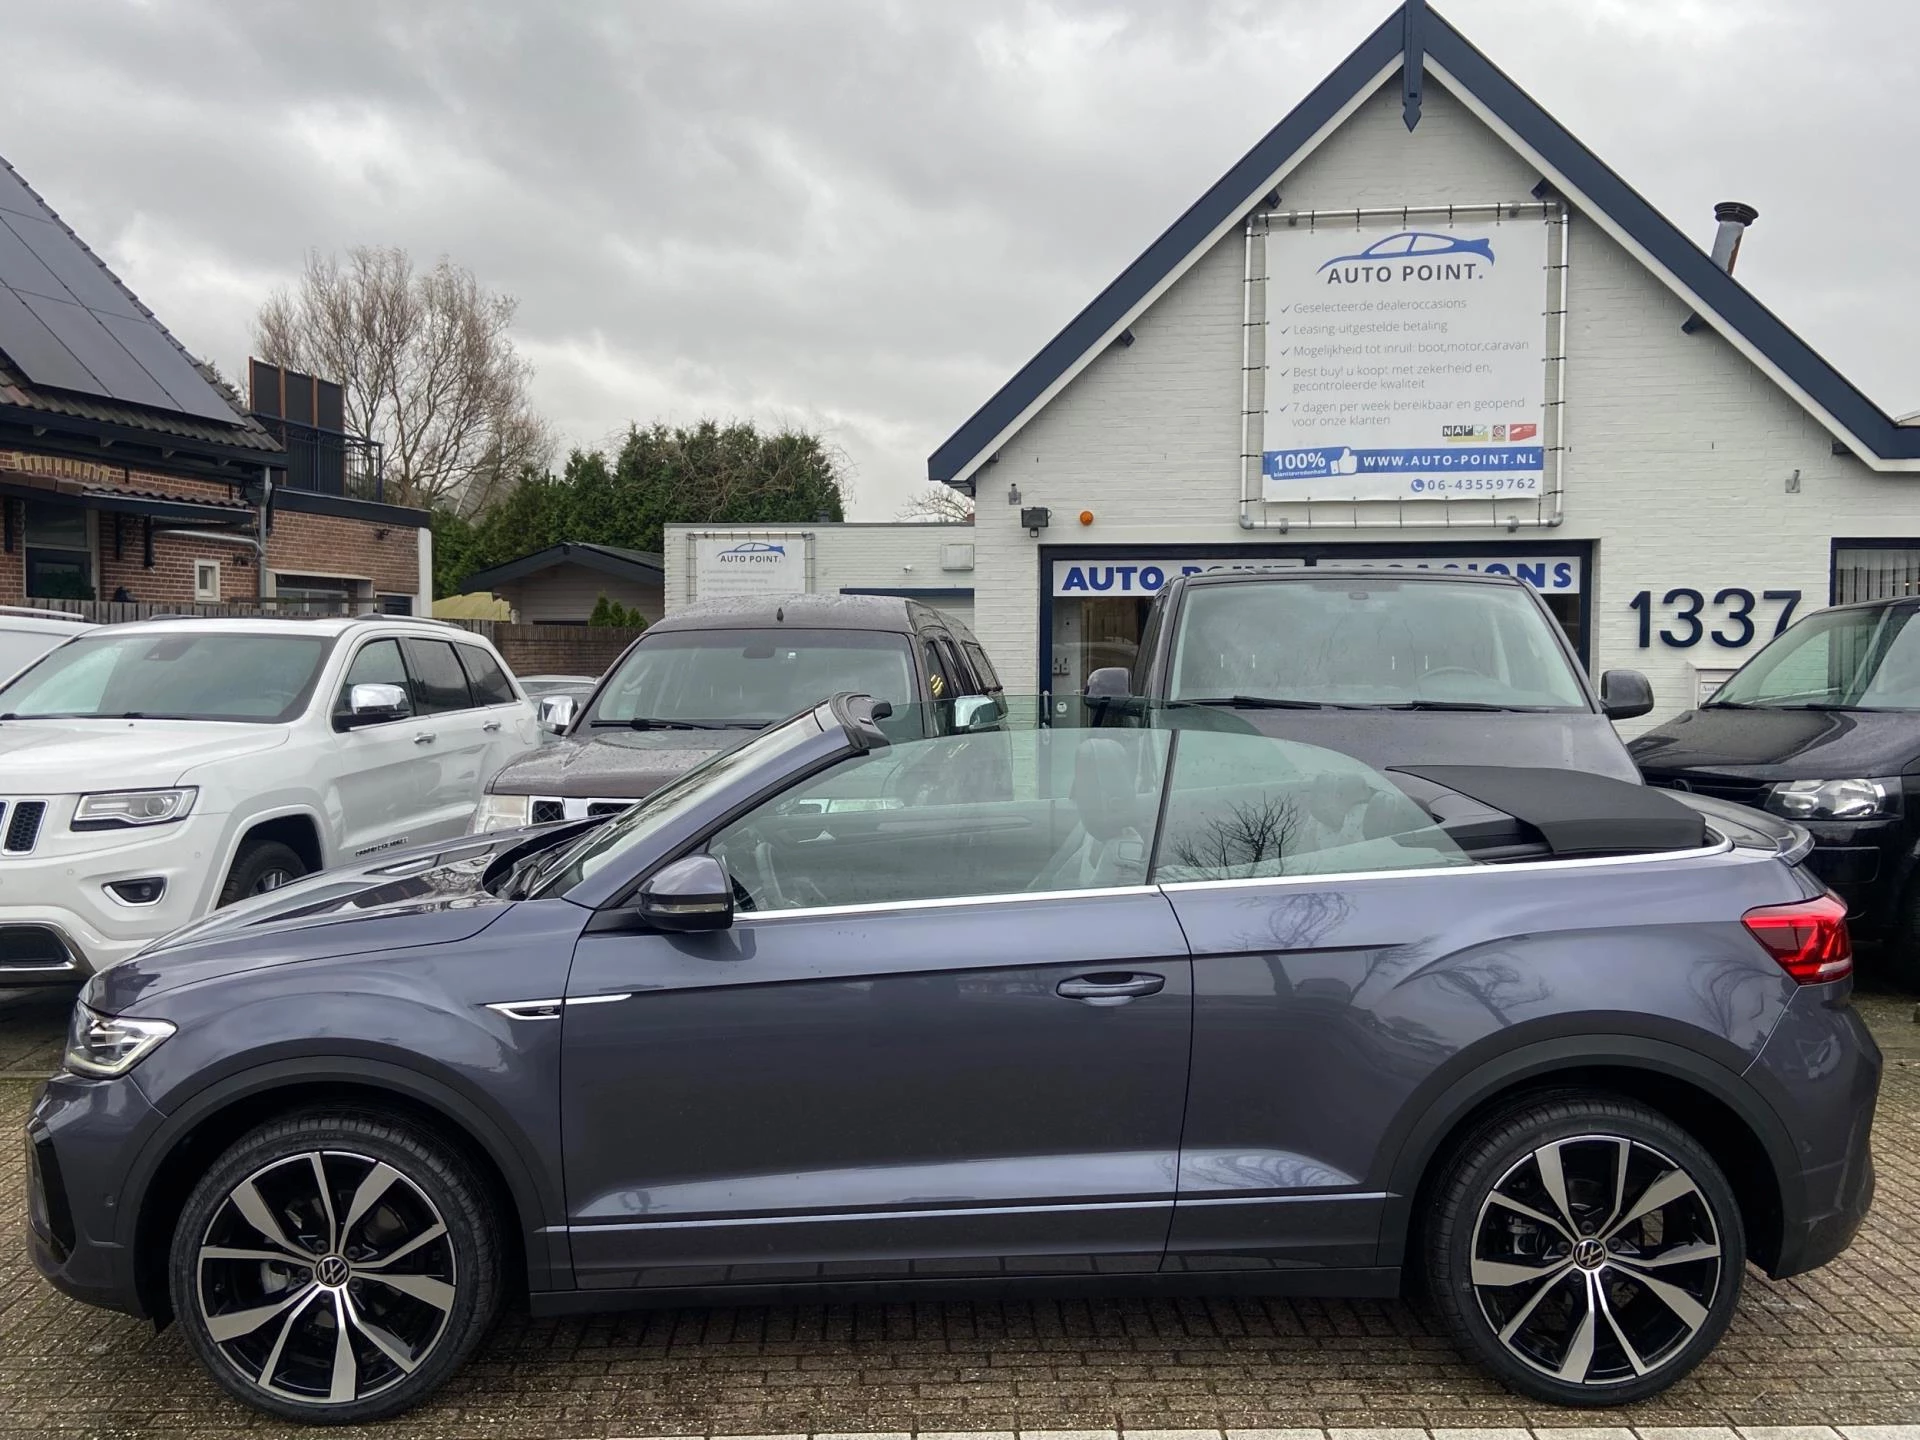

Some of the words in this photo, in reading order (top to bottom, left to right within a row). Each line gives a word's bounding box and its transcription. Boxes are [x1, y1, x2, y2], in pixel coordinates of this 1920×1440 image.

[1327, 266, 1392, 284] AUTO
[1294, 300, 1374, 314] Geselecteerde
[1376, 298, 1467, 312] dealeroccasions
[1403, 319, 1448, 334] betaling
[1294, 344, 1362, 358] Mogelijkheid
[1365, 344, 1381, 354] tot
[1293, 366, 1318, 377] Best
[1357, 363, 1389, 377] koopt
[1392, 364, 1414, 375] met
[1417, 362, 1473, 375] zekerheid
[1292, 380, 1378, 393] gecontroleerde
[1380, 377, 1425, 390] kwaliteit
[1293, 402, 1301, 412] 7
[1302, 401, 1337, 415] dagen
[1340, 403, 1359, 415] per
[1361, 400, 1391, 411] week
[1393, 398, 1453, 411] bereikbaar
[1456, 400, 1471, 409] en
[1474, 397, 1526, 411] geopend
[1292, 418, 1316, 427] voor
[1319, 418, 1347, 426] onze
[1350, 415, 1391, 426] klanten
[1443, 424, 1474, 436] NAP
[1274, 452, 1326, 470] 100%
[1363, 453, 1537, 467] WWW.AUTO-POINT.NL
[1427, 478, 1536, 490] 06-43559762
[720, 555, 746, 563] AUTO
[1061, 567, 1165, 591] AUTO
[1629, 588, 1802, 648] 1337
